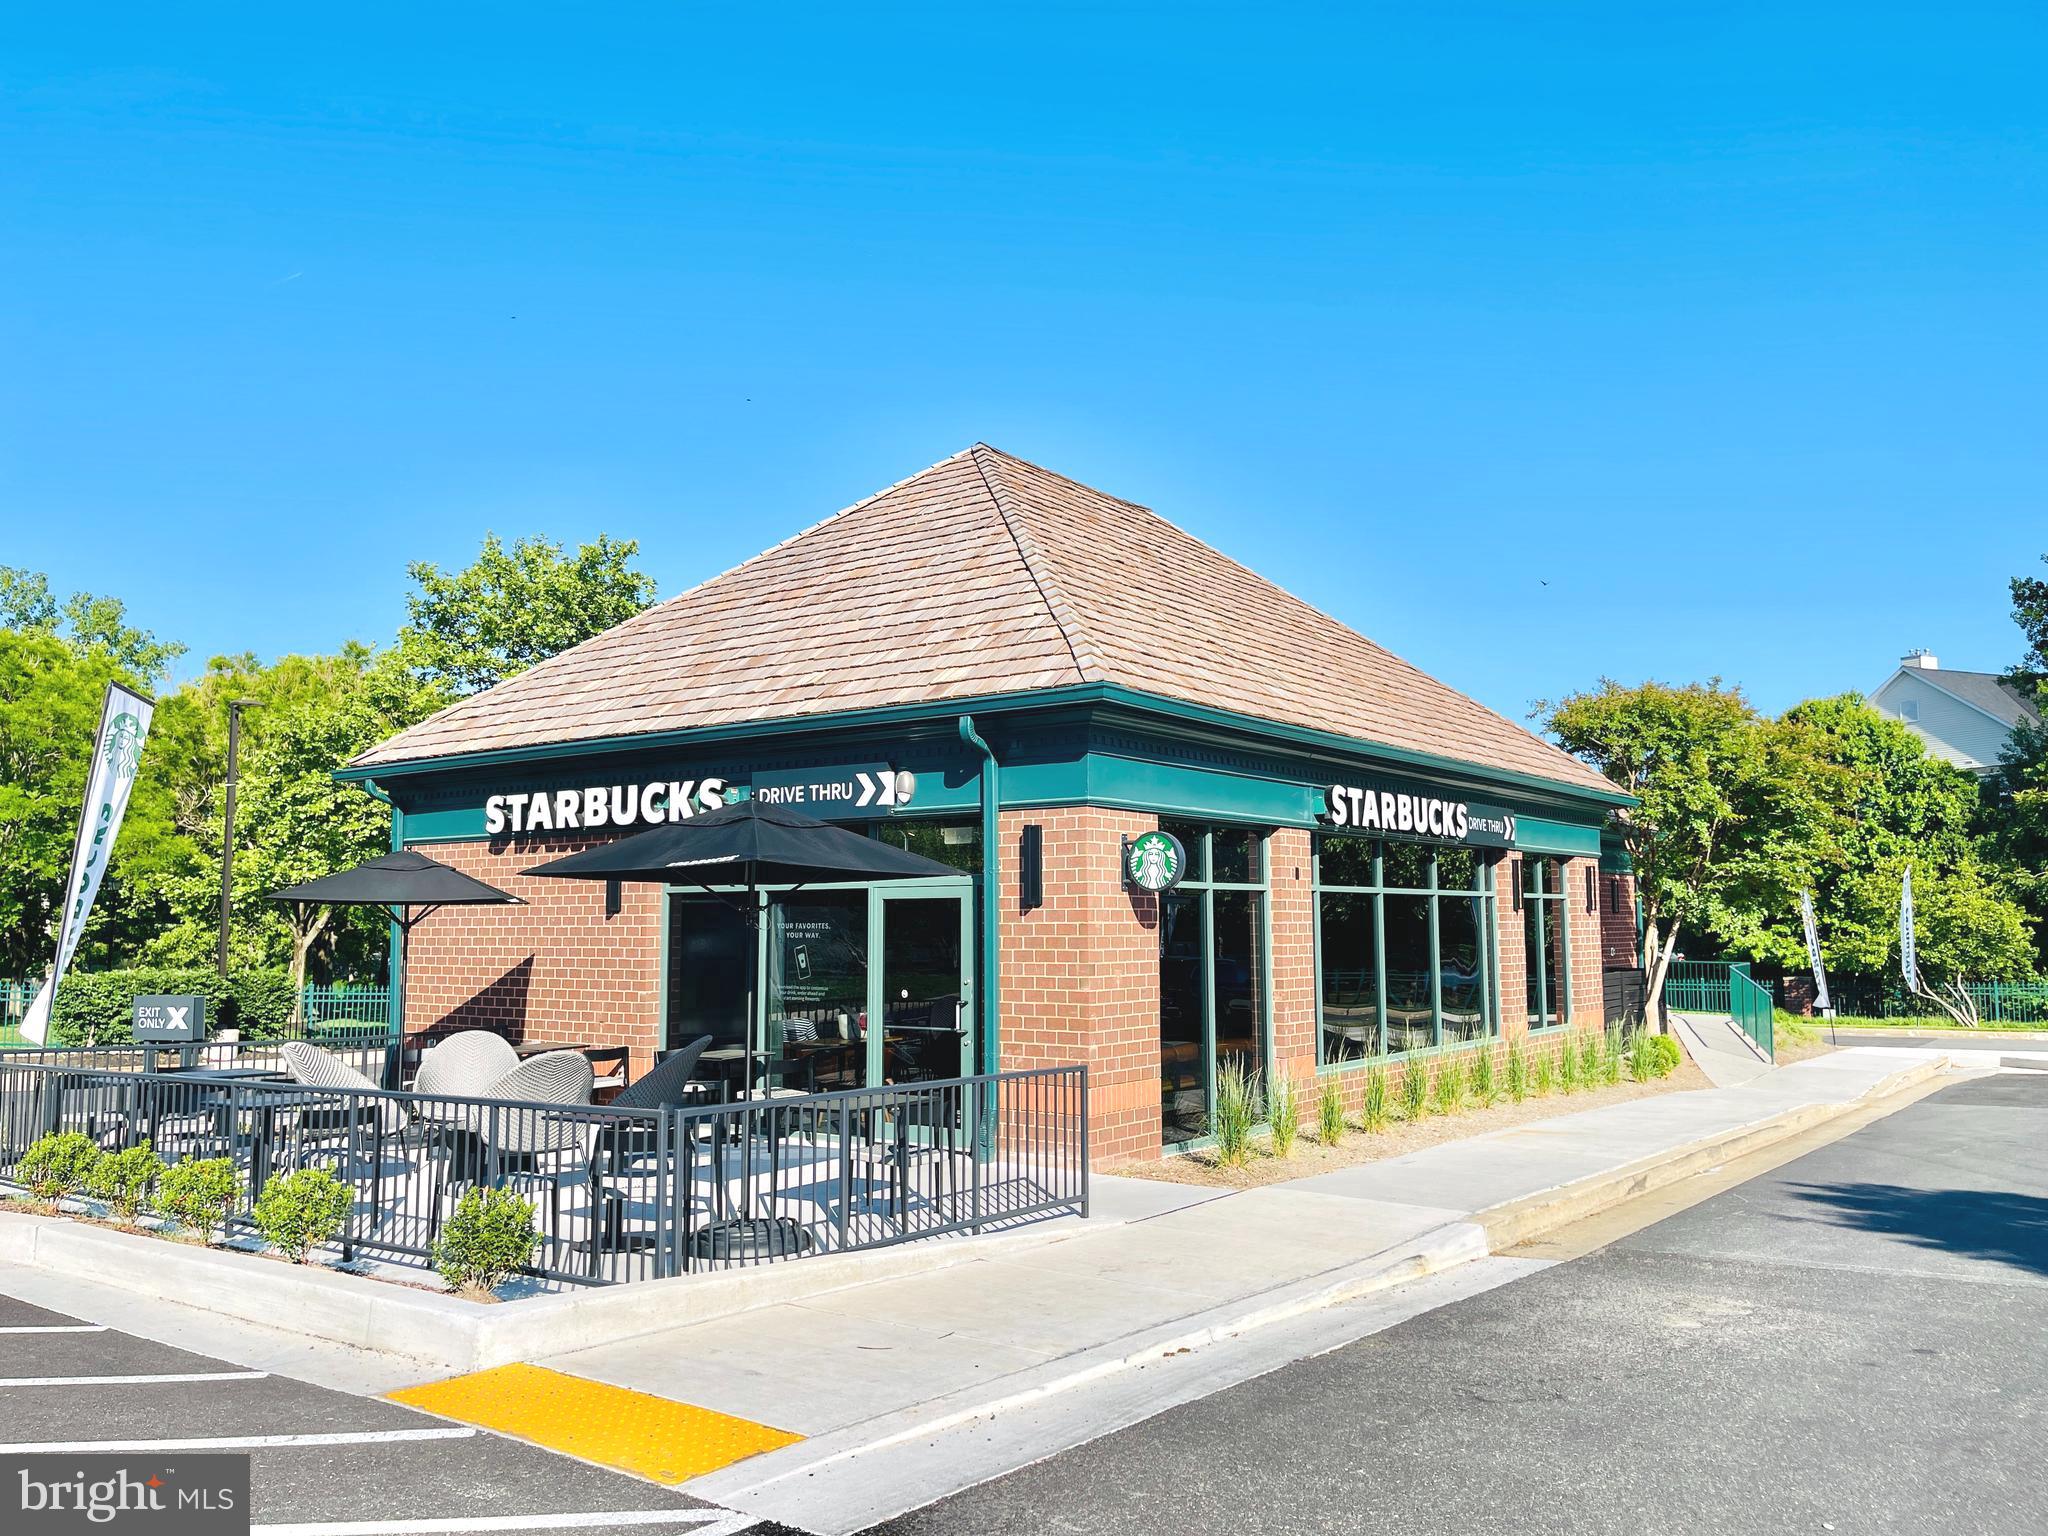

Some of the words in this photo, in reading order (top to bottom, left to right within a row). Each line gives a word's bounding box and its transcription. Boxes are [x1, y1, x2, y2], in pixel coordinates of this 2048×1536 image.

[759, 785, 805, 804] DRIVE
[808, 782, 853, 802] THRU
[485, 778, 724, 835] STARBUCKS
[1331, 784, 1468, 840] STARBUCKS
[1468, 816, 1487, 832] DRIVE
[1487, 819, 1504, 834] THRU
[776, 922, 794, 930] YOUR
[795, 922, 831, 930] FAVORITES.
[138, 1007, 161, 1018] EXIT
[138, 1018, 166, 1029] ONLY
